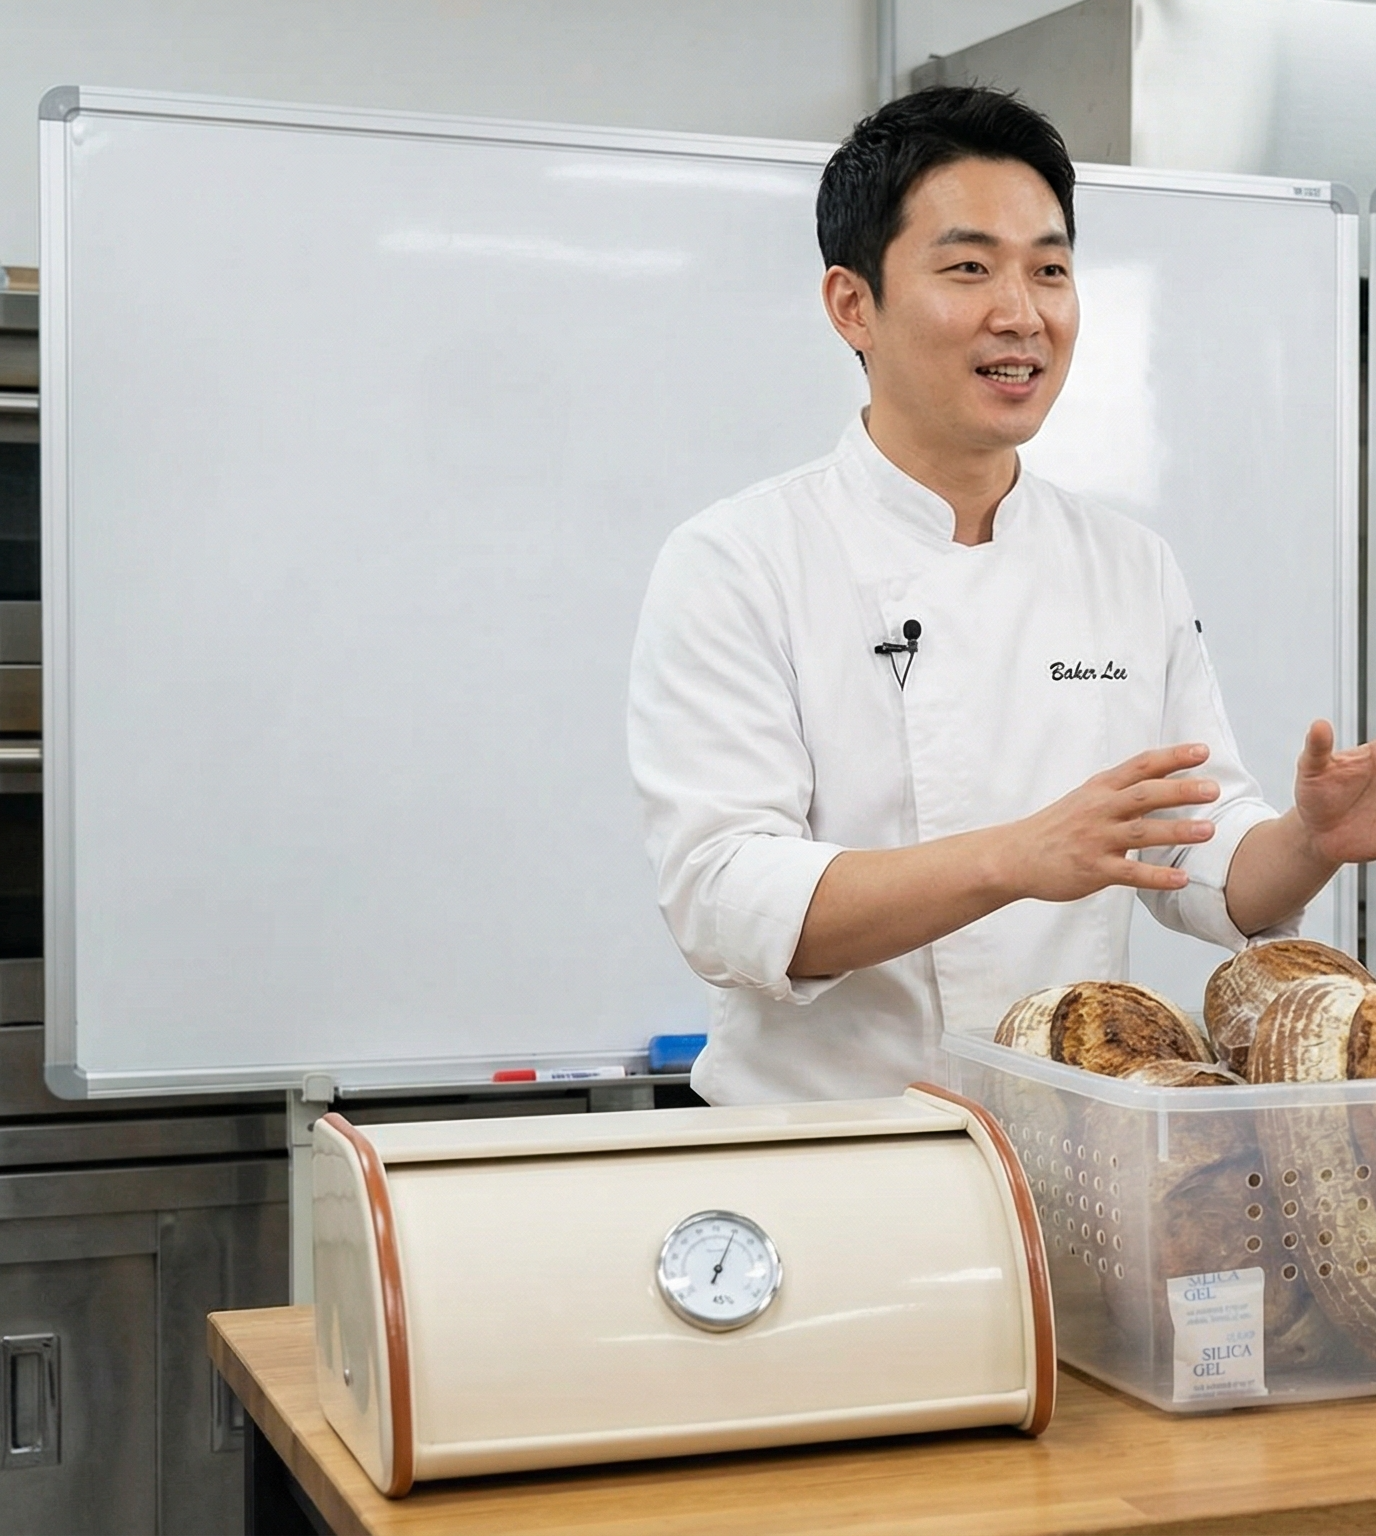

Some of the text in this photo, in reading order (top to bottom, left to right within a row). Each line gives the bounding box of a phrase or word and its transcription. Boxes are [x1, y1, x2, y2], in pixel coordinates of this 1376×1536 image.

[1050, 661, 1128, 680] Baker Lee
[1184, 1287, 1216, 1301] GEL
[1202, 1344, 1252, 1361] SILICA
[1193, 1362, 1225, 1377] GEL
